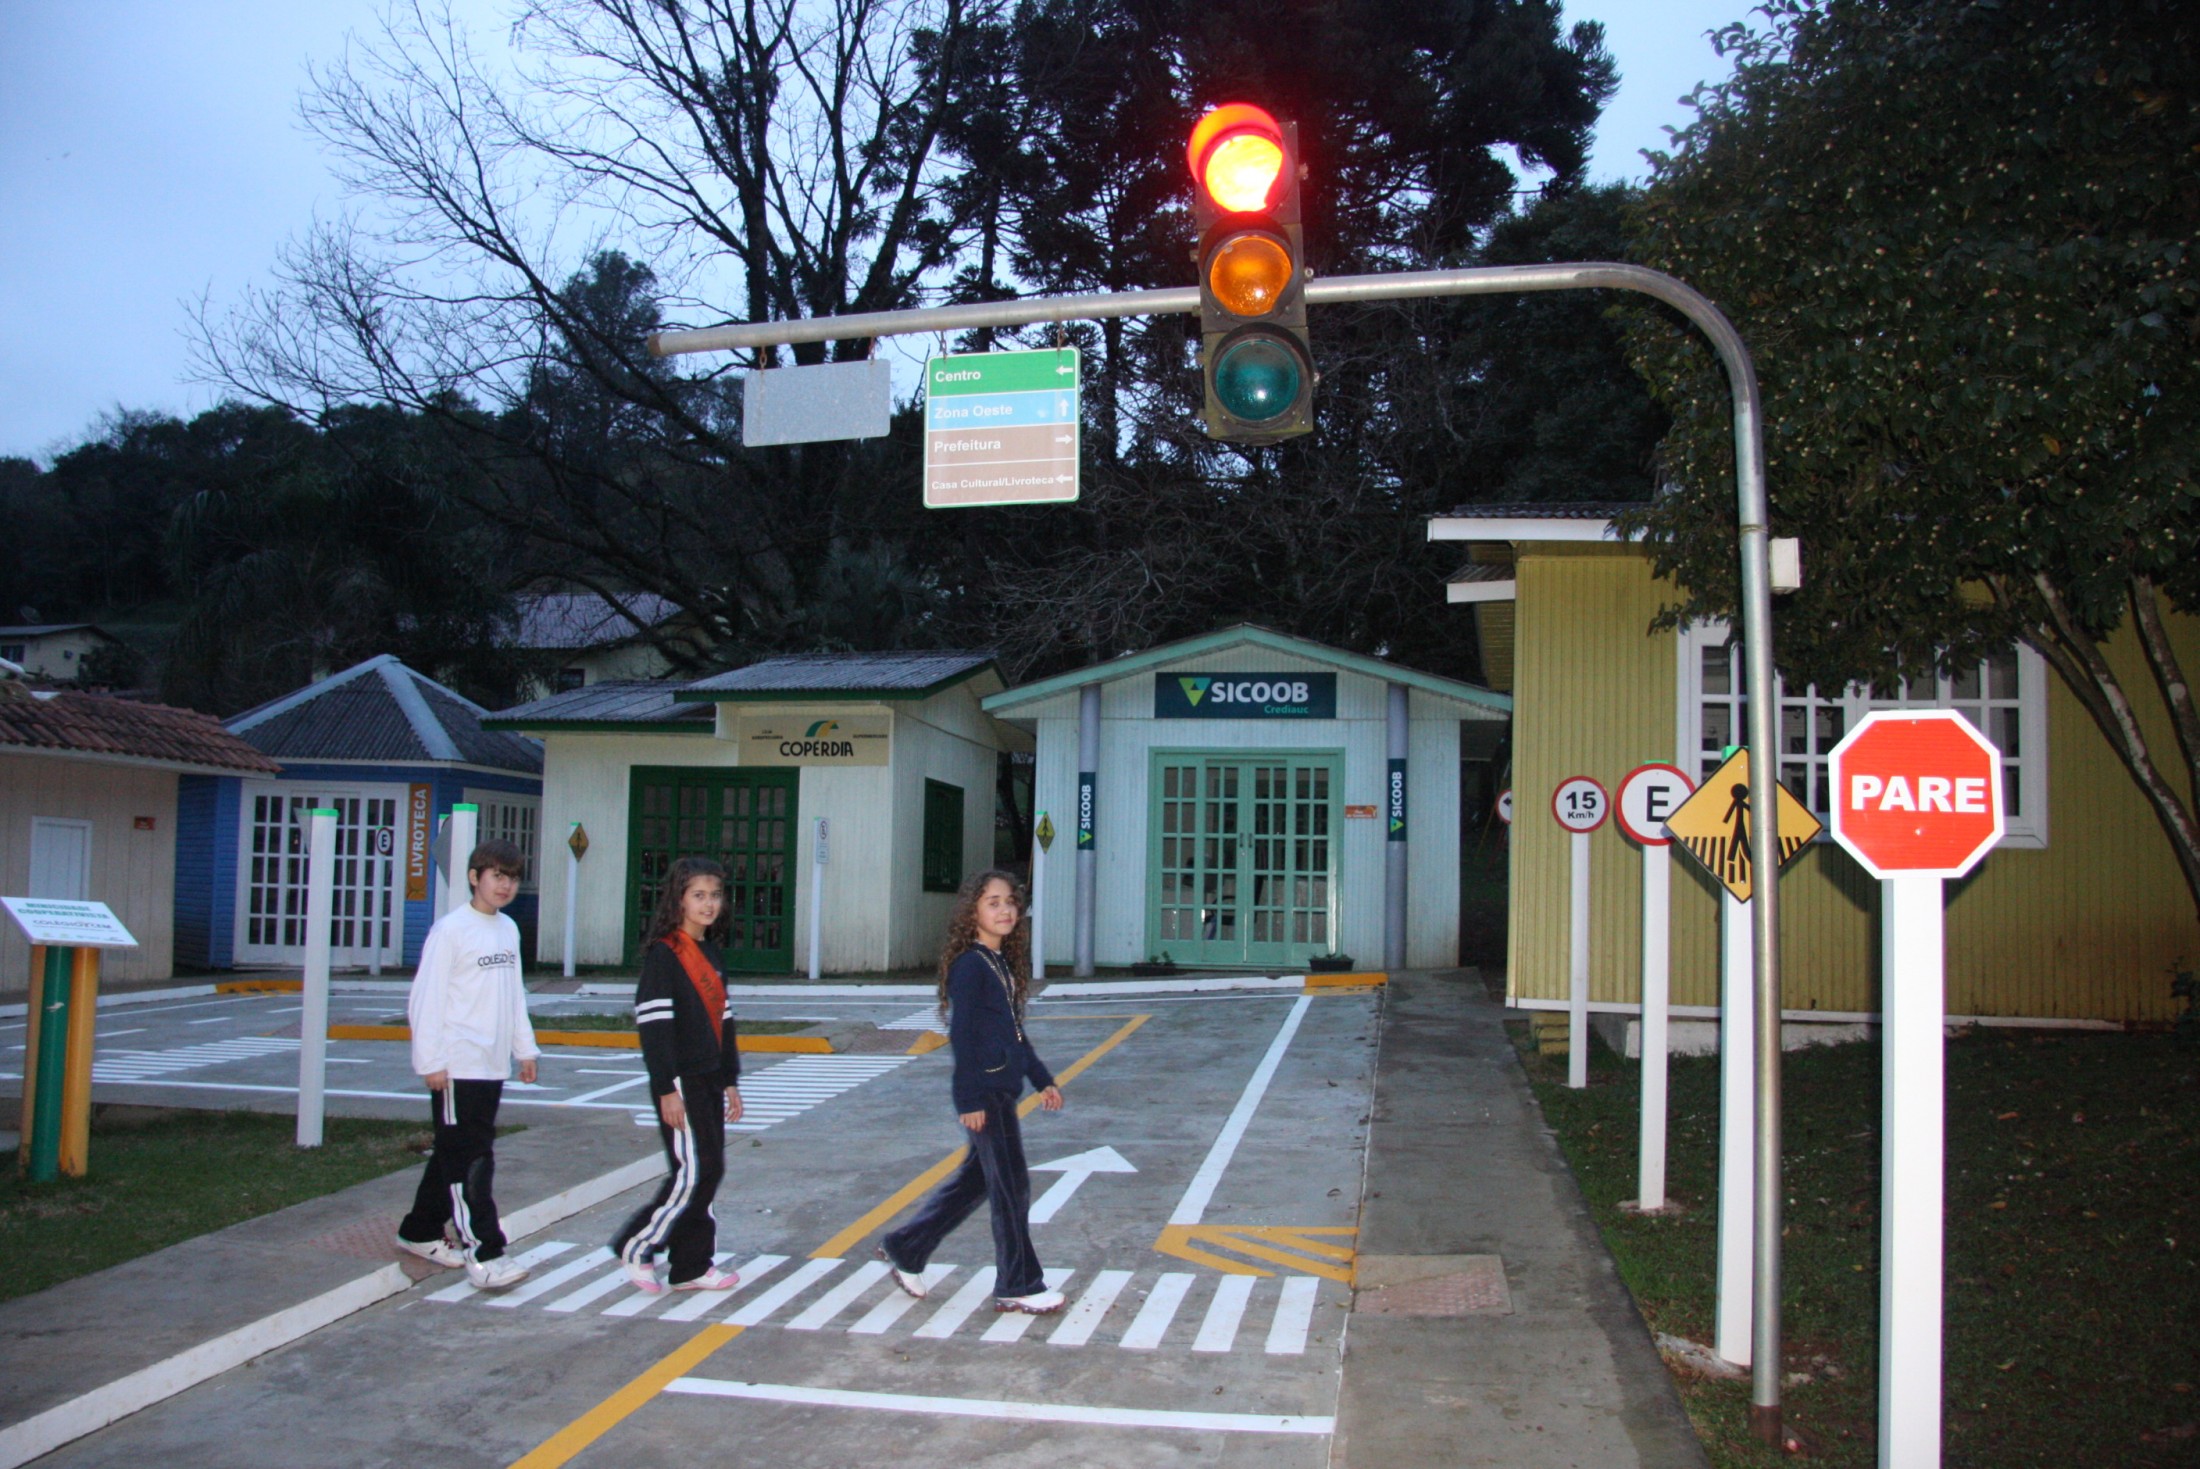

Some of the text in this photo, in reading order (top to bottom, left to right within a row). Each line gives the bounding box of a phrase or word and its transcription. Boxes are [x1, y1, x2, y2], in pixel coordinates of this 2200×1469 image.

[935, 369, 982, 383] Centro
[934, 404, 1013, 419] Zona Oeste
[934, 439, 1001, 452] Prefeitura
[931, 480, 957, 490] Casa
[1211, 681, 1309, 703] SICOOB
[1264, 704, 1309, 714] Crediauc
[779, 740, 854, 757] COPÉRDIA
[1391, 771, 1402, 817] SICOOB
[1566, 791, 1597, 810] 15
[1851, 774, 1986, 813] PARE
[1081, 784, 1091, 829] SICOOB
[1646, 785, 1670, 822] E
[1567, 811, 1595, 819] Km/h
[381, 834, 388, 848] E
[411, 788, 427, 877] LIVROTECA
